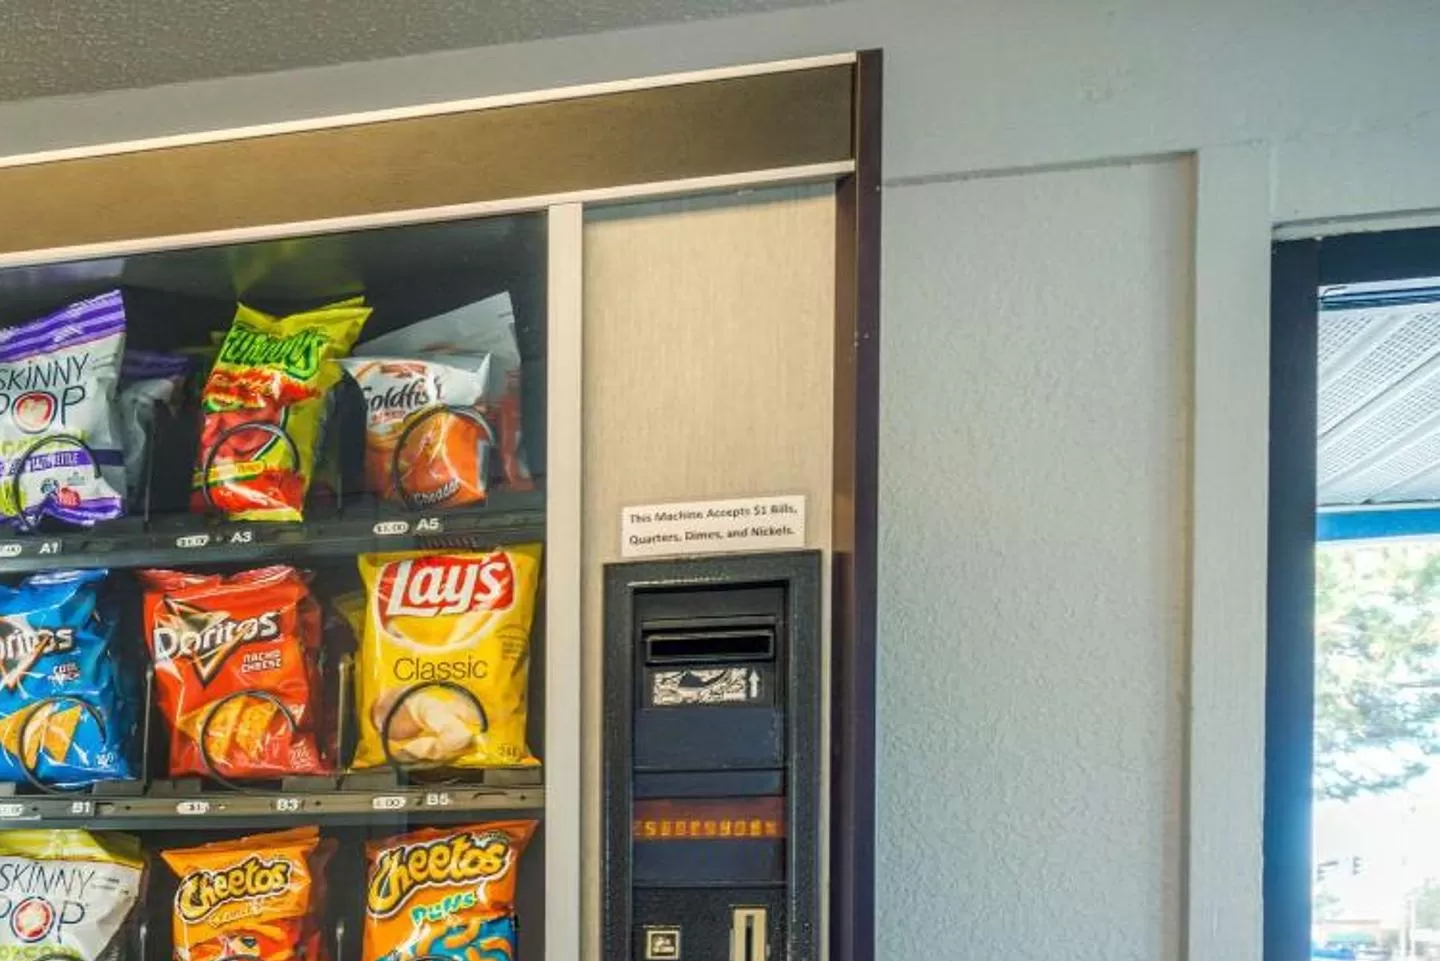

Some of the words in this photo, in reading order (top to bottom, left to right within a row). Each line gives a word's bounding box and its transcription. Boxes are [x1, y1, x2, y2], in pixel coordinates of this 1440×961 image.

[630, 514, 651, 524] This
[654, 510, 703, 521] Machine
[706, 508, 750, 520] Accepts
[417, 518, 439, 531] A5
[231, 532, 252, 543] A3
[727, 528, 748, 538] and
[40, 543, 58, 554] A1
[387, 553, 508, 616] Lay's
[155, 611, 281, 660] Doritos
[393, 656, 488, 681] Classic
[72, 802, 91, 814] B1
[277, 799, 298, 811] B3
[368, 835, 509, 914] Cheetos
[177, 857, 291, 920] Cheetos
